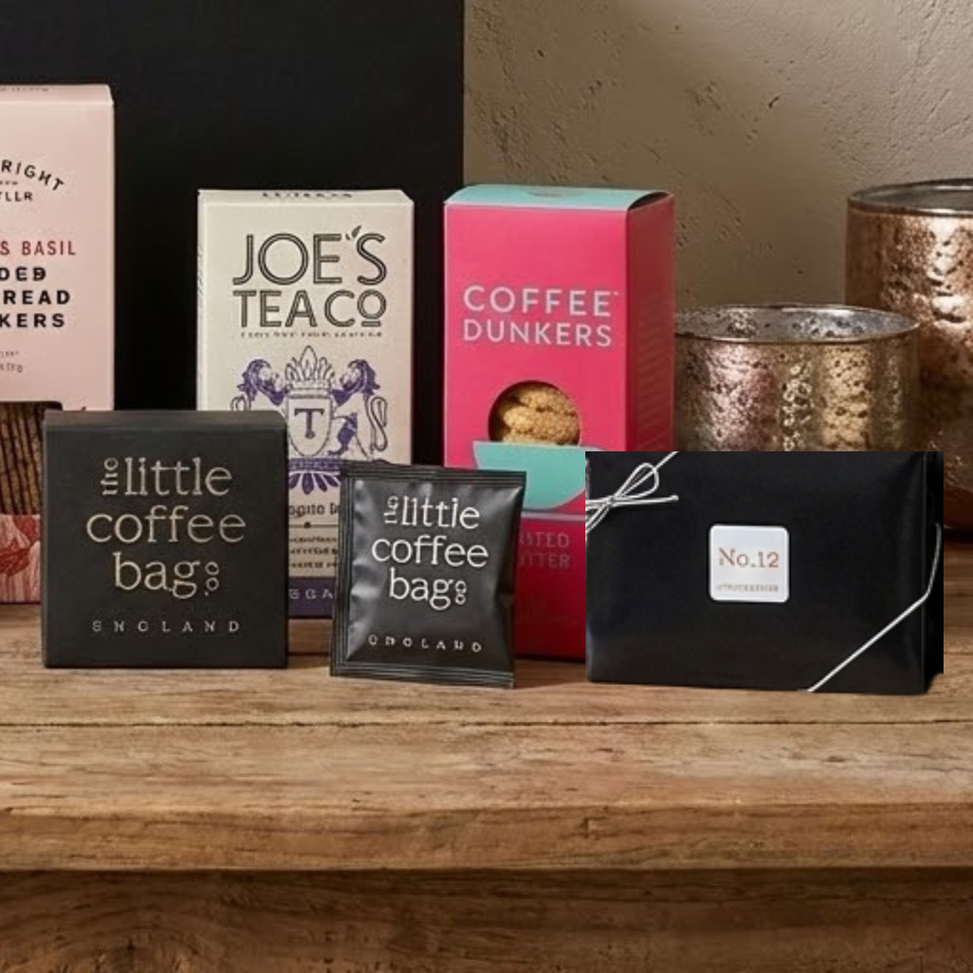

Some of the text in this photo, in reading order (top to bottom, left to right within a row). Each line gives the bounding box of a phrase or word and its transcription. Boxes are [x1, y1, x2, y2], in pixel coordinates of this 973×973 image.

[21, 240, 76, 256] BASIL
[232, 226, 388, 286] JOE'S
[232, 289, 318, 328] TEA
[463, 285, 612, 317] COFFEE
[463, 318, 612, 347] DUNKERS
[124, 456, 233, 496] little
[86, 504, 247, 544] coffee
[371, 534, 489, 568] coffee
[718, 547, 779, 568] No.12
[112, 551, 201, 600] bag
[389, 566, 454, 611] bag
